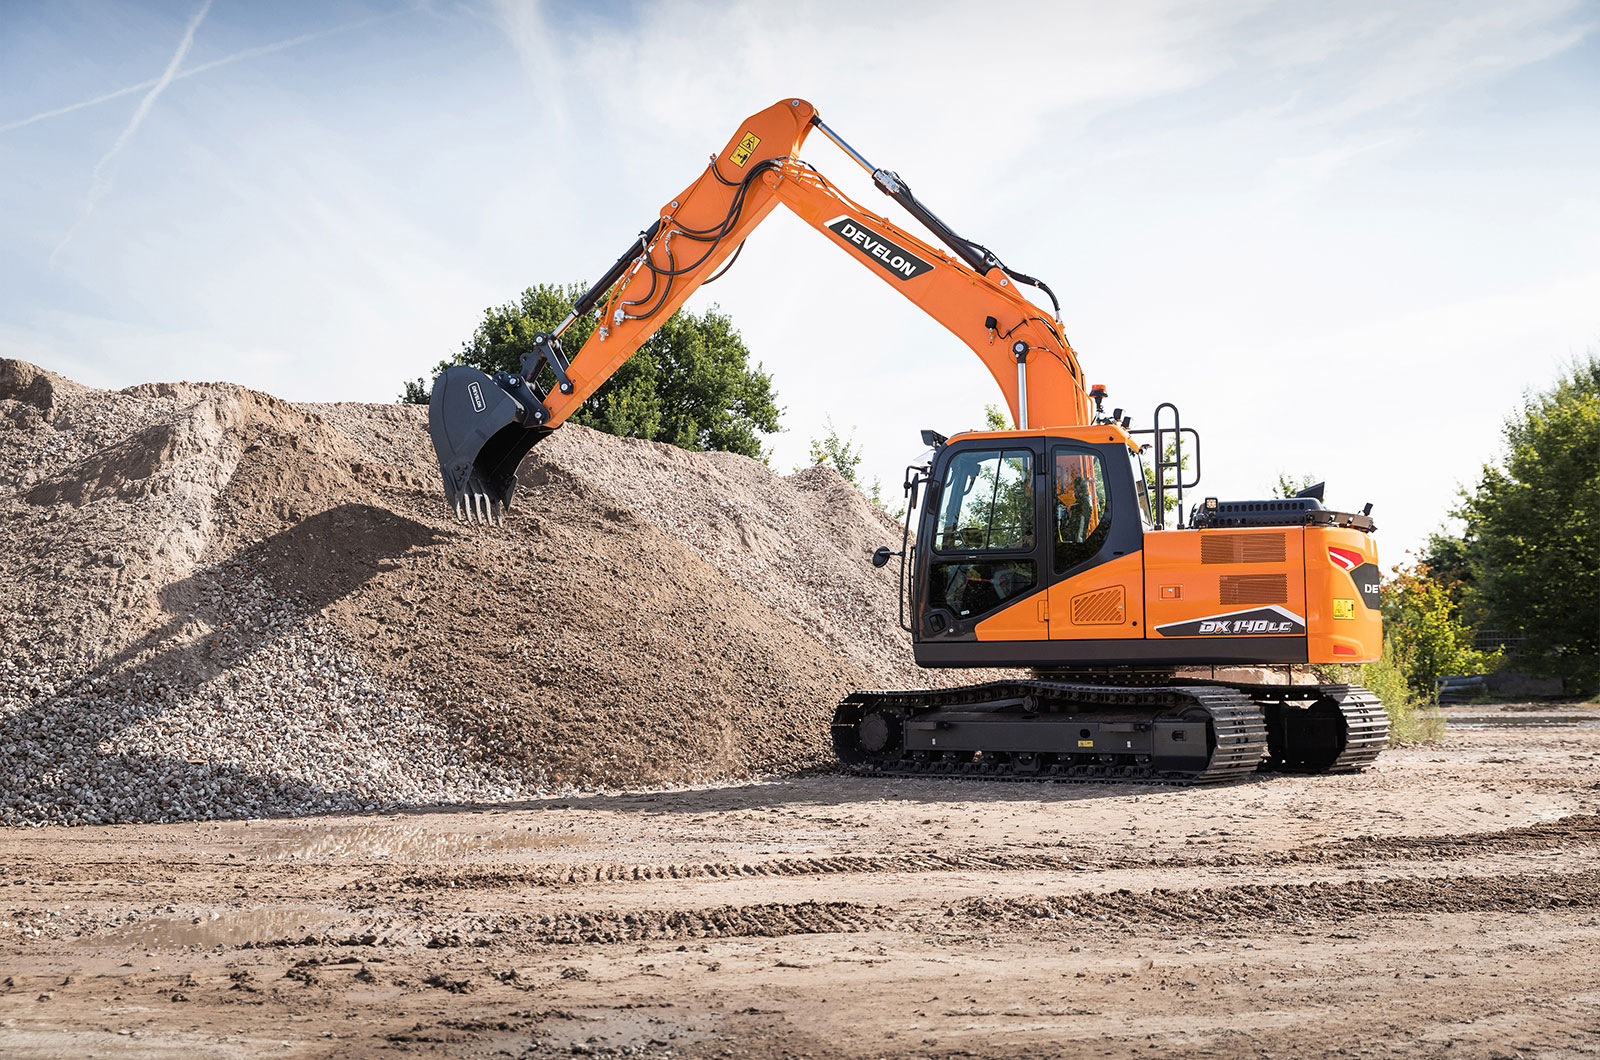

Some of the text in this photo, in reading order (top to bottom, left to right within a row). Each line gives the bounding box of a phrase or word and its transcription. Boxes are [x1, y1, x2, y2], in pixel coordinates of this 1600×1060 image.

[841, 223, 917, 277] DEVELON
[471, 385, 482, 408] DEVELON
[1364, 584, 1381, 594] DE
[1199, 620, 1231, 634] DX
